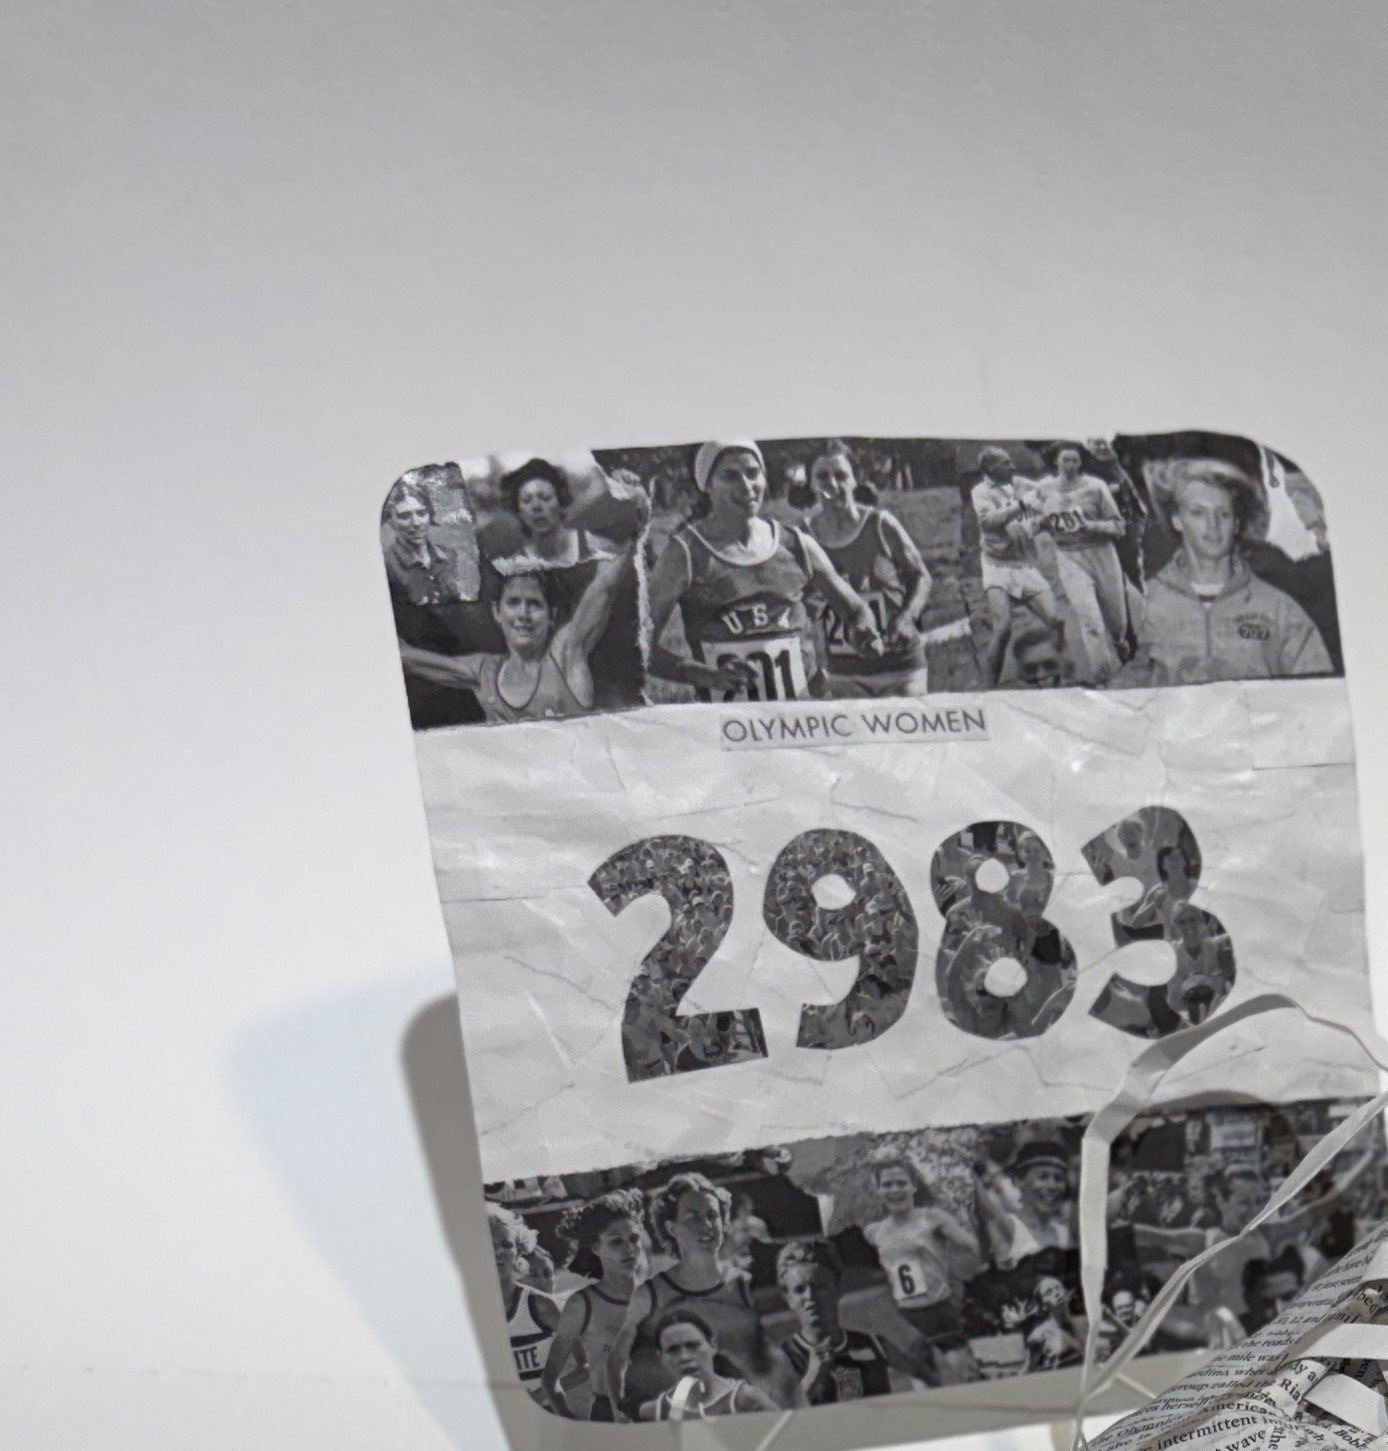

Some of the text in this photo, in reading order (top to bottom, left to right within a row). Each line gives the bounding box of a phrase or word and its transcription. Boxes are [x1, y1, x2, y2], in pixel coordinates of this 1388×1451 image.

[722, 708, 987, 743] OLYMPIC WOMEN
[587, 805, 1238, 1082] 2983
[898, 1263, 916, 1296] 6
[1157, 1416, 1257, 1451] intermittent
